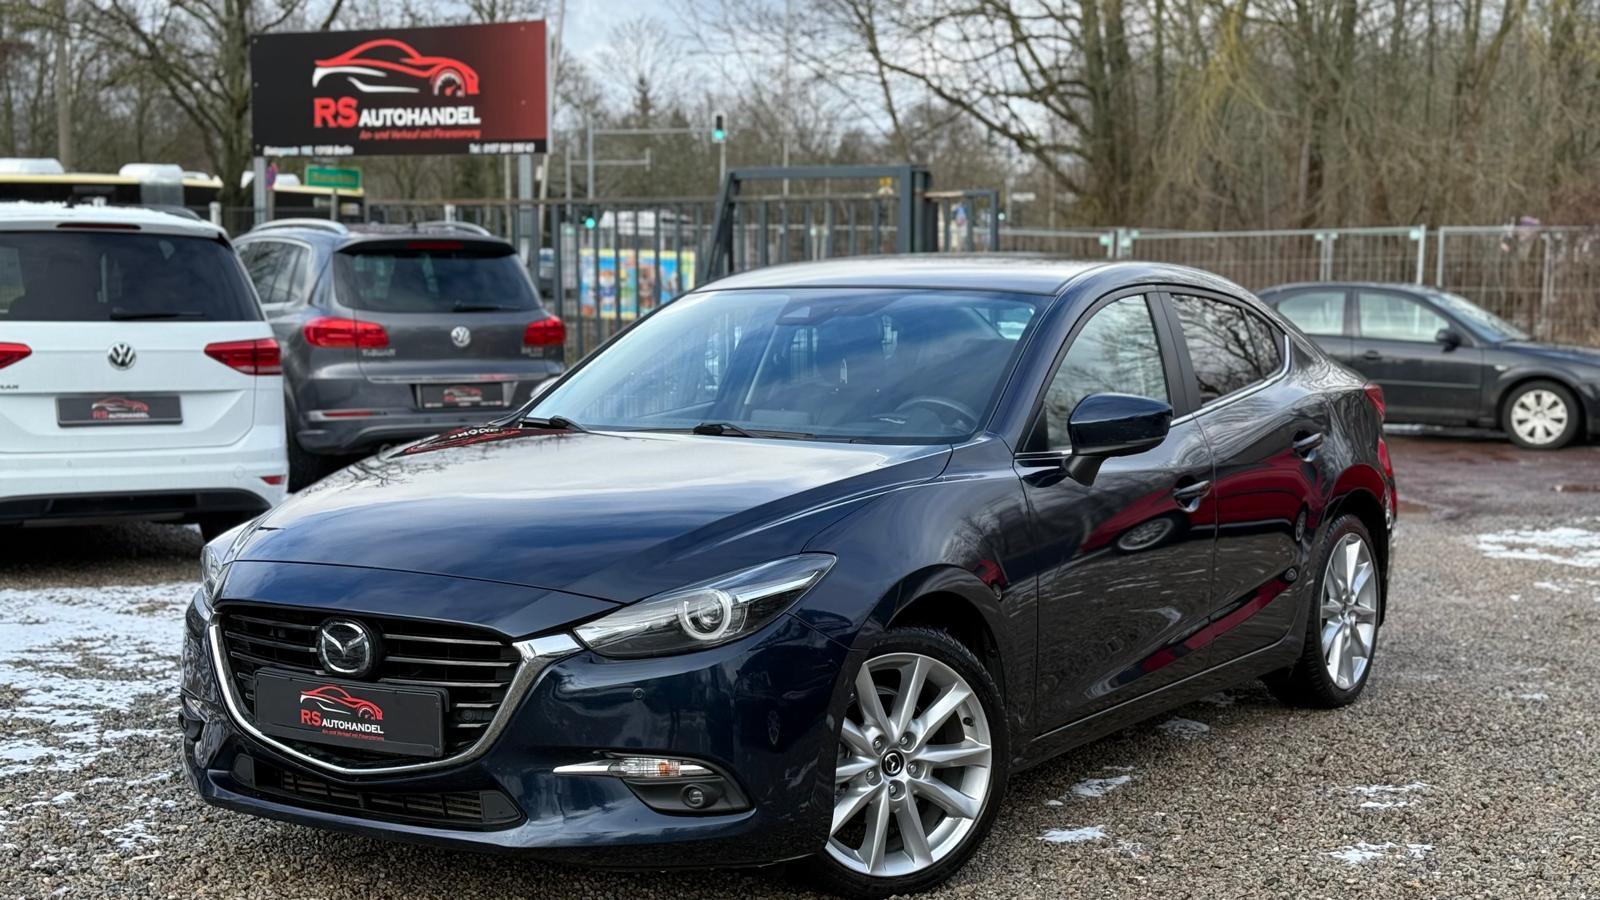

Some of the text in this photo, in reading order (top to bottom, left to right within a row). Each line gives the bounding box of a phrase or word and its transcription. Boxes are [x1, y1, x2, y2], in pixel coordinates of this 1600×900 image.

[313, 97, 481, 128] RS AUTOHANDEL
[300, 709, 384, 734] RS AUTOHANDEL
